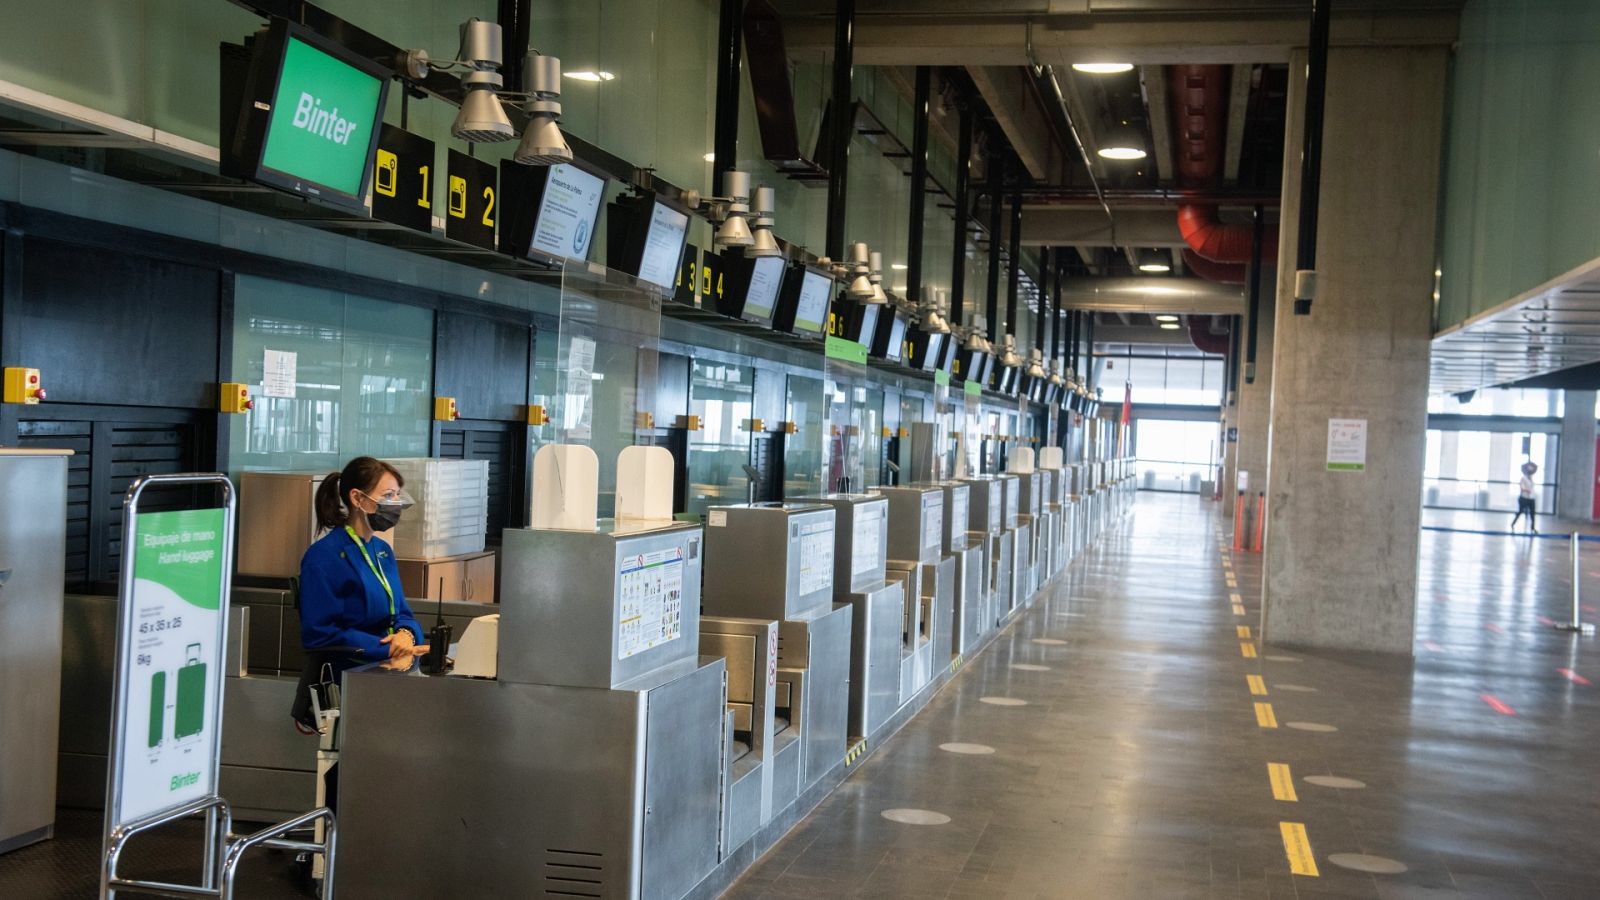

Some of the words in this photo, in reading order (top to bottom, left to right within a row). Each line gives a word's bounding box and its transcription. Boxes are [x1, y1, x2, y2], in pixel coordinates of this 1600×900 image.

[292, 91, 357, 145] Binter
[417, 165, 431, 209] 1
[482, 186, 495, 227] 2
[689, 262, 696, 291] 3
[717, 272, 724, 299] 4
[144, 533, 179, 548] Equipaje
[181, 531, 192, 543] de
[193, 531, 215, 541] mano
[159, 551, 181, 565] Hand
[182, 549, 214, 564] luggage
[139, 622, 149, 634] 45
[155, 619, 165, 631] 35
[172, 616, 182, 629] 25
[137, 653, 151, 667] 6kg
[170, 771, 201, 791] Binter
